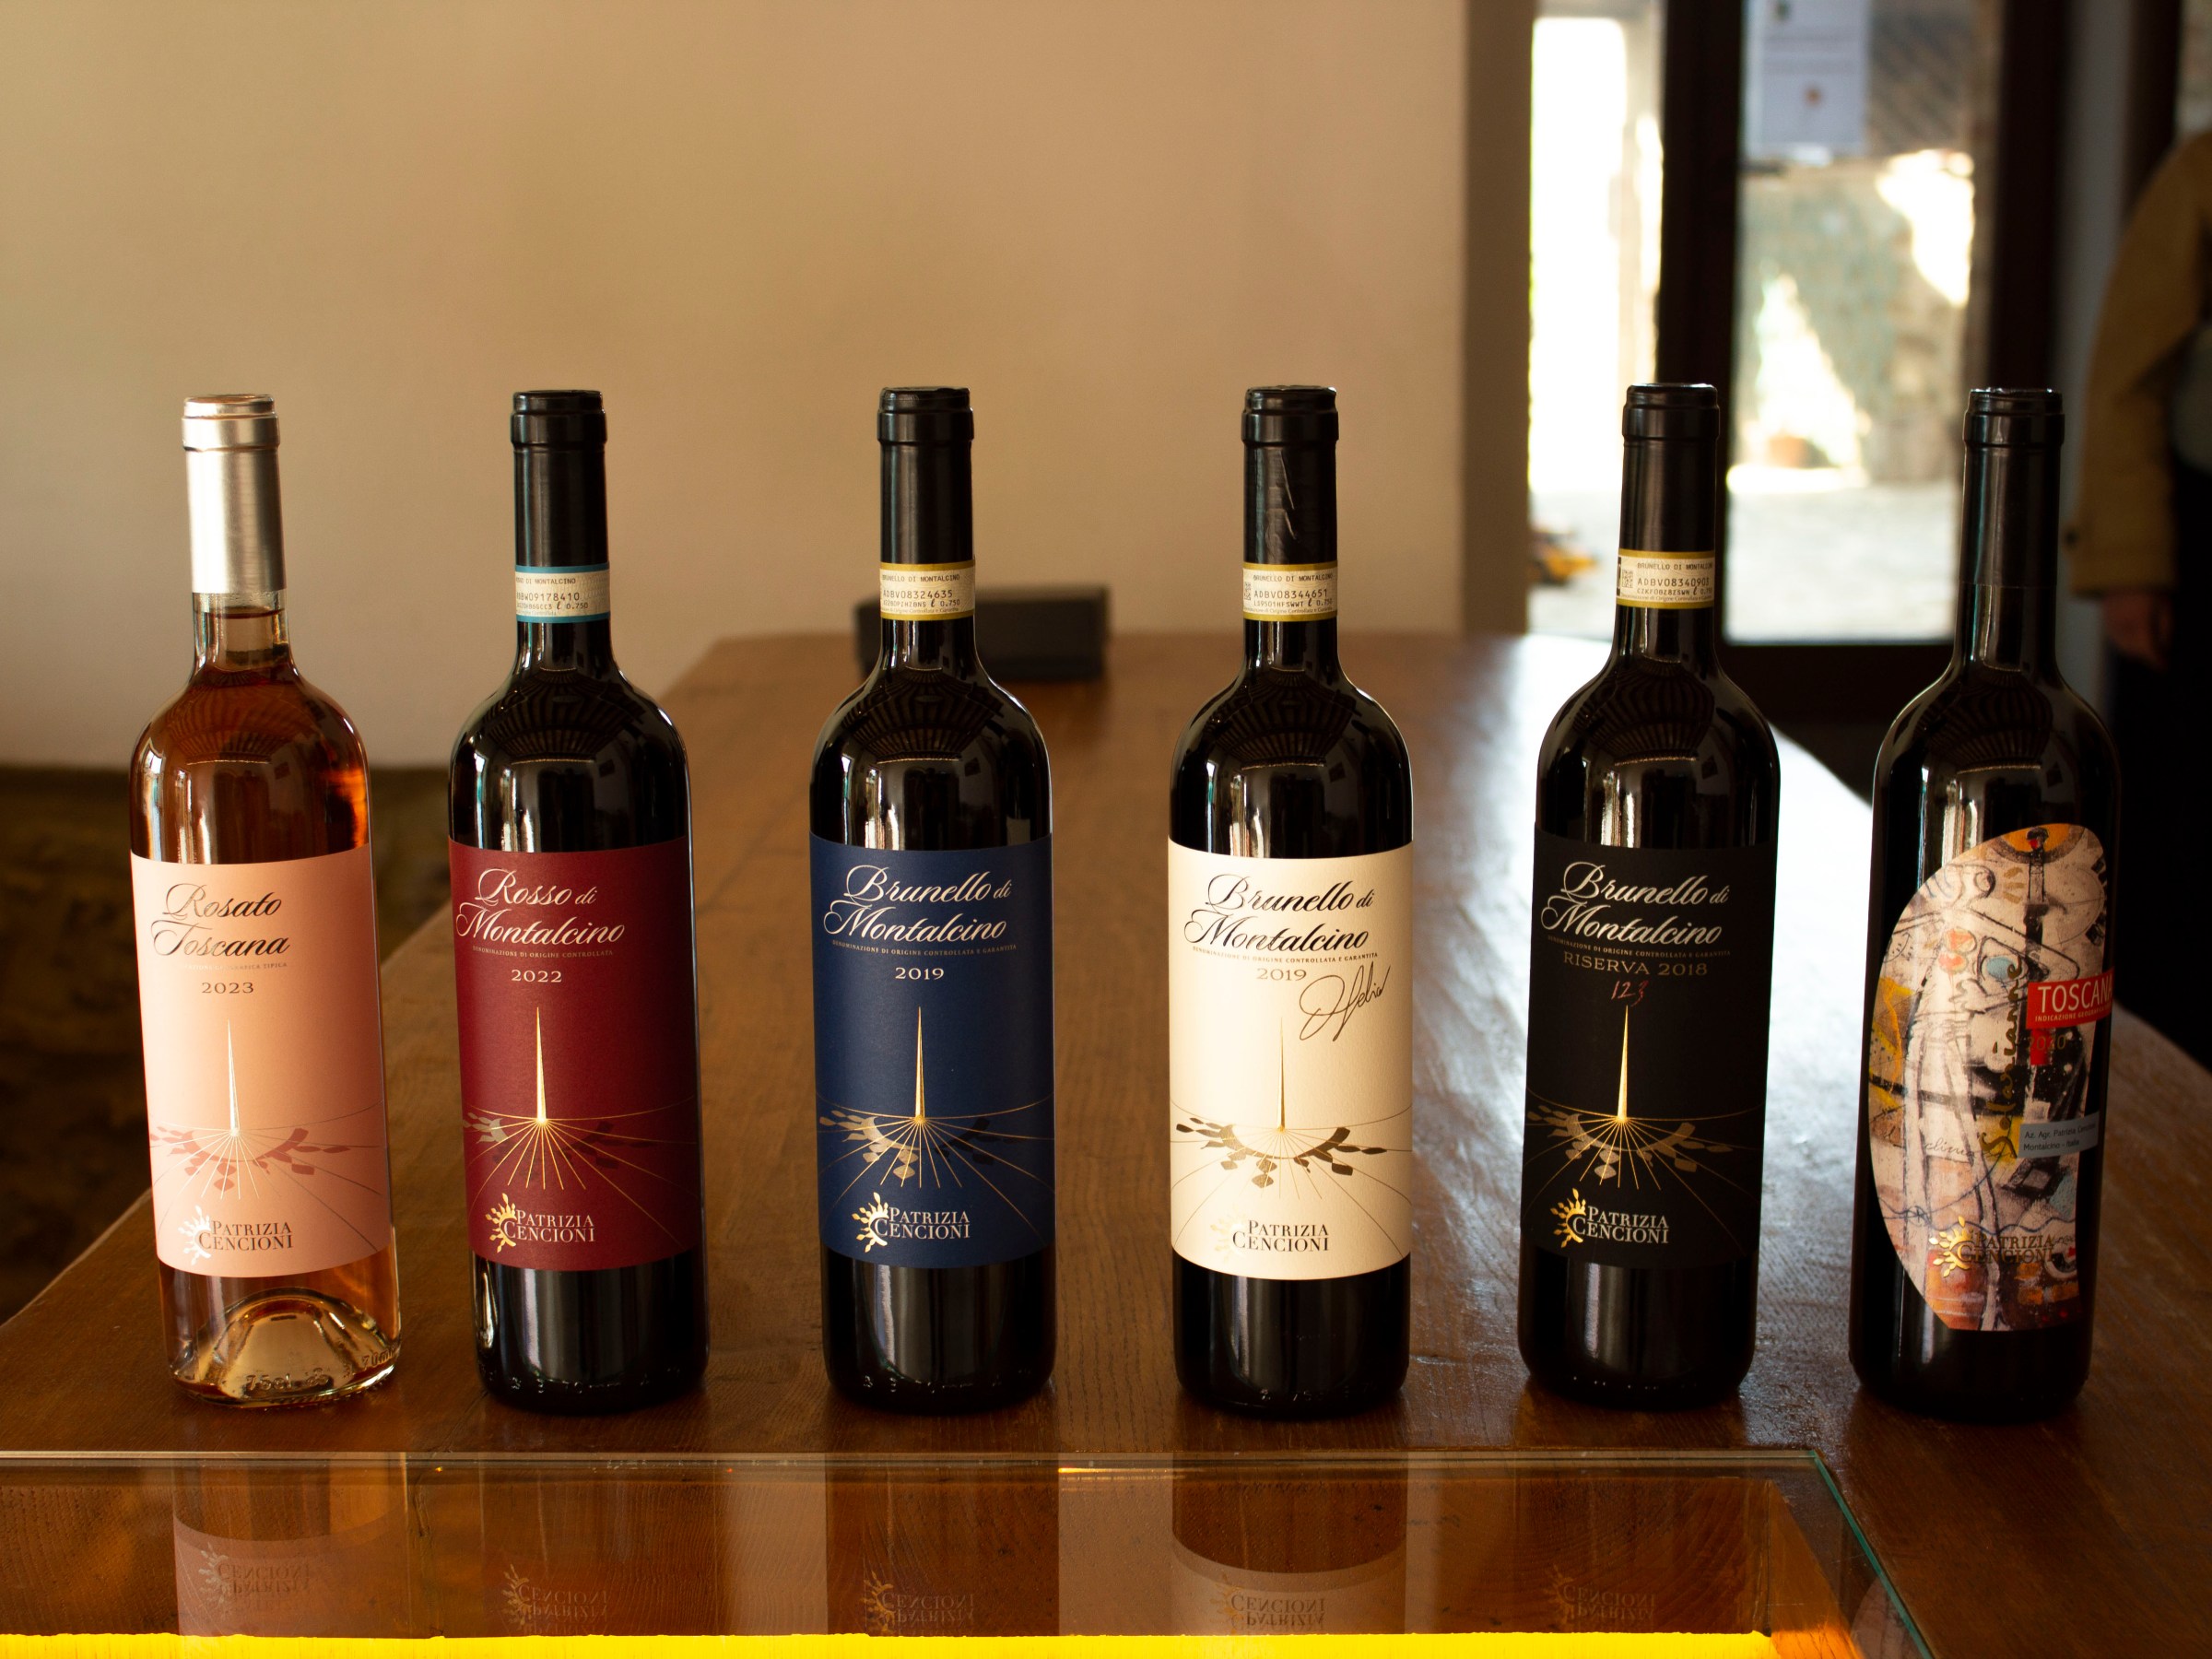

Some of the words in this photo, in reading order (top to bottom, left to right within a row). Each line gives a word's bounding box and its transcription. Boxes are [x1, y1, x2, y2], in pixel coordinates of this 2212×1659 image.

[940, 599, 960, 607] 0.750
[474, 868, 572, 907] Rosso
[574, 886, 597, 905] di
[843, 865, 992, 906] Brunello
[994, 879, 1012, 899] di
[1560, 861, 1708, 905] Brunello
[1710, 885, 1730, 904] di
[161, 883, 282, 920] Rosato
[1205, 874, 1354, 912] Brunello
[1356, 888, 1375, 908] di
[456, 902, 626, 945] Montalcino
[824, 900, 1006, 943] Montalcino
[1541, 895, 1723, 945] Montalcino
[151, 920, 290, 956] Toscana
[1183, 909, 1370, 951] Montalcino
[472, 946, 517, 957] DENOMINAZIONE
[562, 949, 613, 959] CONTROLLATA
[833, 939, 879, 953] DENOMINAZIONE
[982, 945, 1017, 954] GARANTITA
[1603, 947, 1633, 957] ORIGINE
[1635, 950, 1687, 959] CONTROLLATA
[1695, 949, 1731, 958] GARANTITA
[1345, 952, 1378, 961] GARANTITA
[1564, 951, 1650, 975] RISERVA
[1658, 962, 1707, 976] 2018
[512, 969, 562, 982] 2022
[895, 967, 944, 980] 2019
[1256, 969, 1307, 981] 2019
[202, 982, 254, 994] 2023
[2035, 1013, 2077, 1022] INDICAZIONE
[2038, 1130, 2051, 1140] Agr.
[2053, 1128, 2076, 1137] Patrizia
[2023, 1142, 2061, 1151] Montalcino
[516, 1209, 594, 1228] PATRIZIA
[889, 1207, 970, 1225] PATRIZIA
[1587, 1206, 1669, 1229] PATRIZIA
[212, 1220, 292, 1236] PATRIZIA
[504, 1220, 595, 1242] CENCIONI
[875, 1219, 970, 1240] CENCIONI
[1248, 1219, 1328, 1237] PATRIZIA
[1572, 1217, 1669, 1244] CENCIONI
[199, 1231, 293, 1251] CENCIONI
[1233, 1231, 1329, 1253] CENCIONI
[1975, 1232, 2054, 1249] PATRIZIA
[1960, 1245, 2054, 1264] CENCIONI
